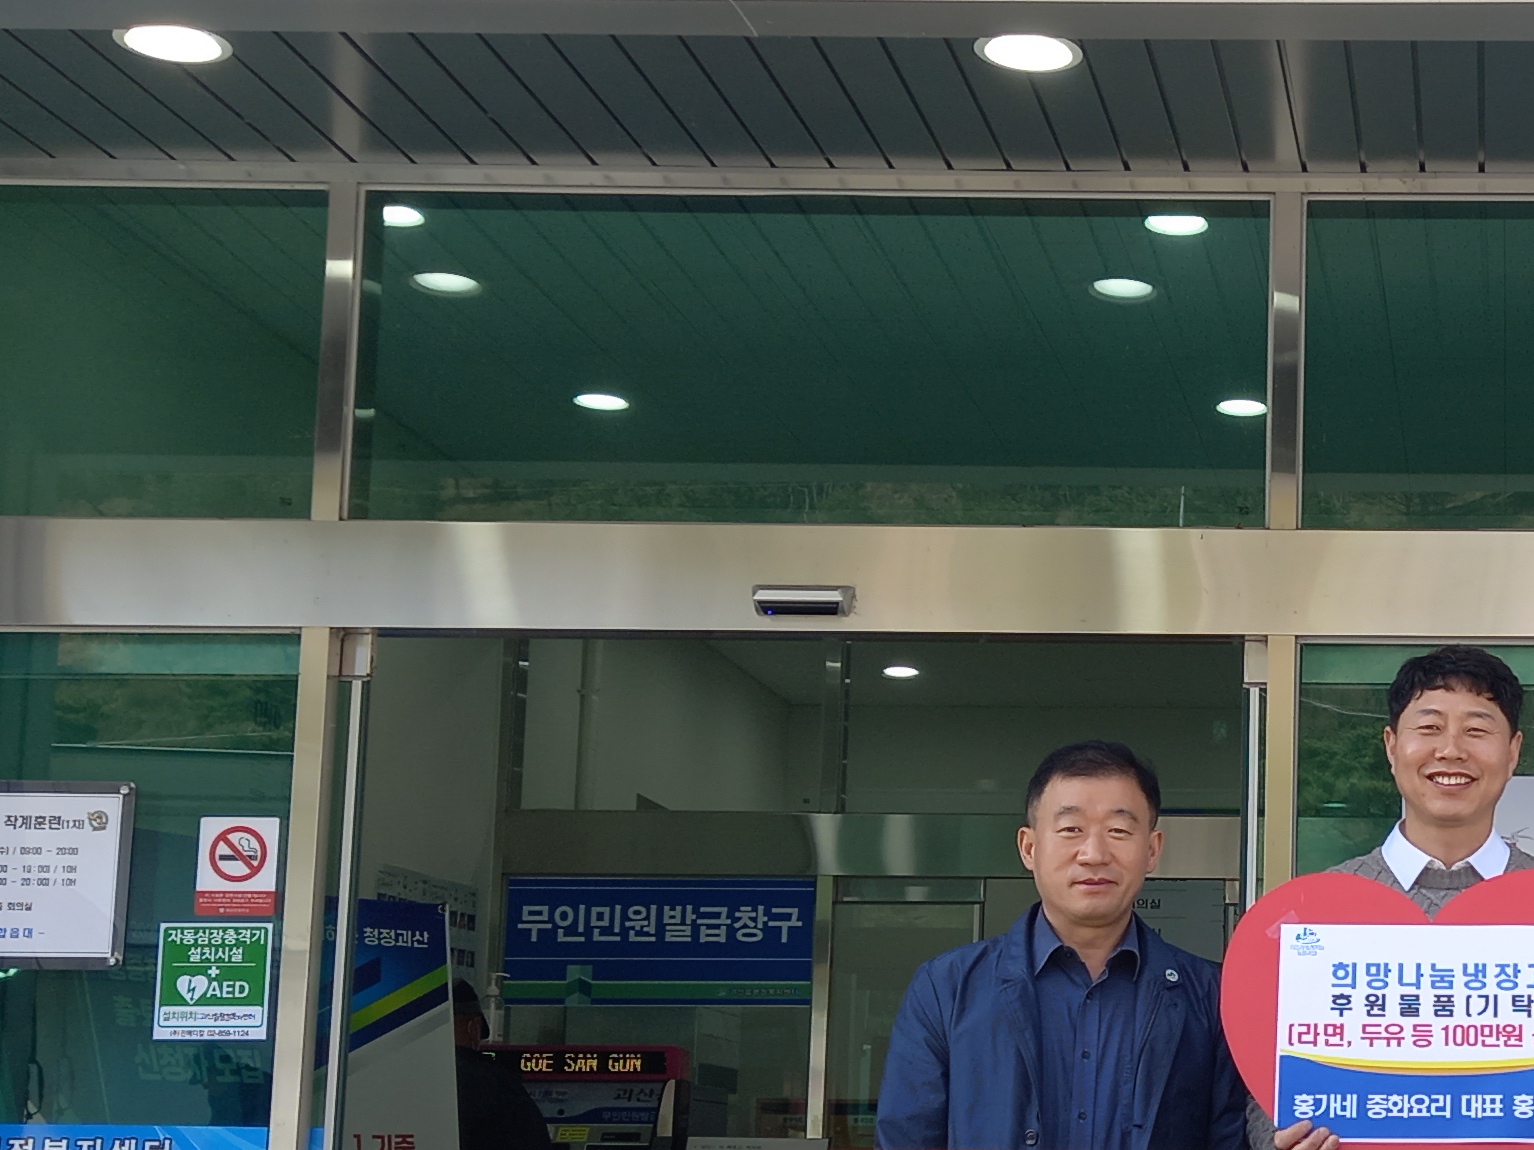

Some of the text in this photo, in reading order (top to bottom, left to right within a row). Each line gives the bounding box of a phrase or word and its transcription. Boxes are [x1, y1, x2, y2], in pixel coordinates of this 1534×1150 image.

[517, 903, 803, 943] 무인민원발급창구
[168, 929, 264, 944] 자동심장충격기
[362, 928, 430, 948] 청정괴산
[188, 947, 243, 962] 설치시설
[206, 982, 249, 998] AED
[1360, 1024, 1406, 1047] 두유
[1411, 1024, 1434, 1048] 등
[1441, 1024, 1523, 1048] 100만원
[520, 1053, 642, 1072] GOE SAN GUN
[1292, 1094, 1357, 1118] 홍가네
[1366, 1094, 1451, 1118] 중화요리
[1461, 1094, 1504, 1118] 대표
